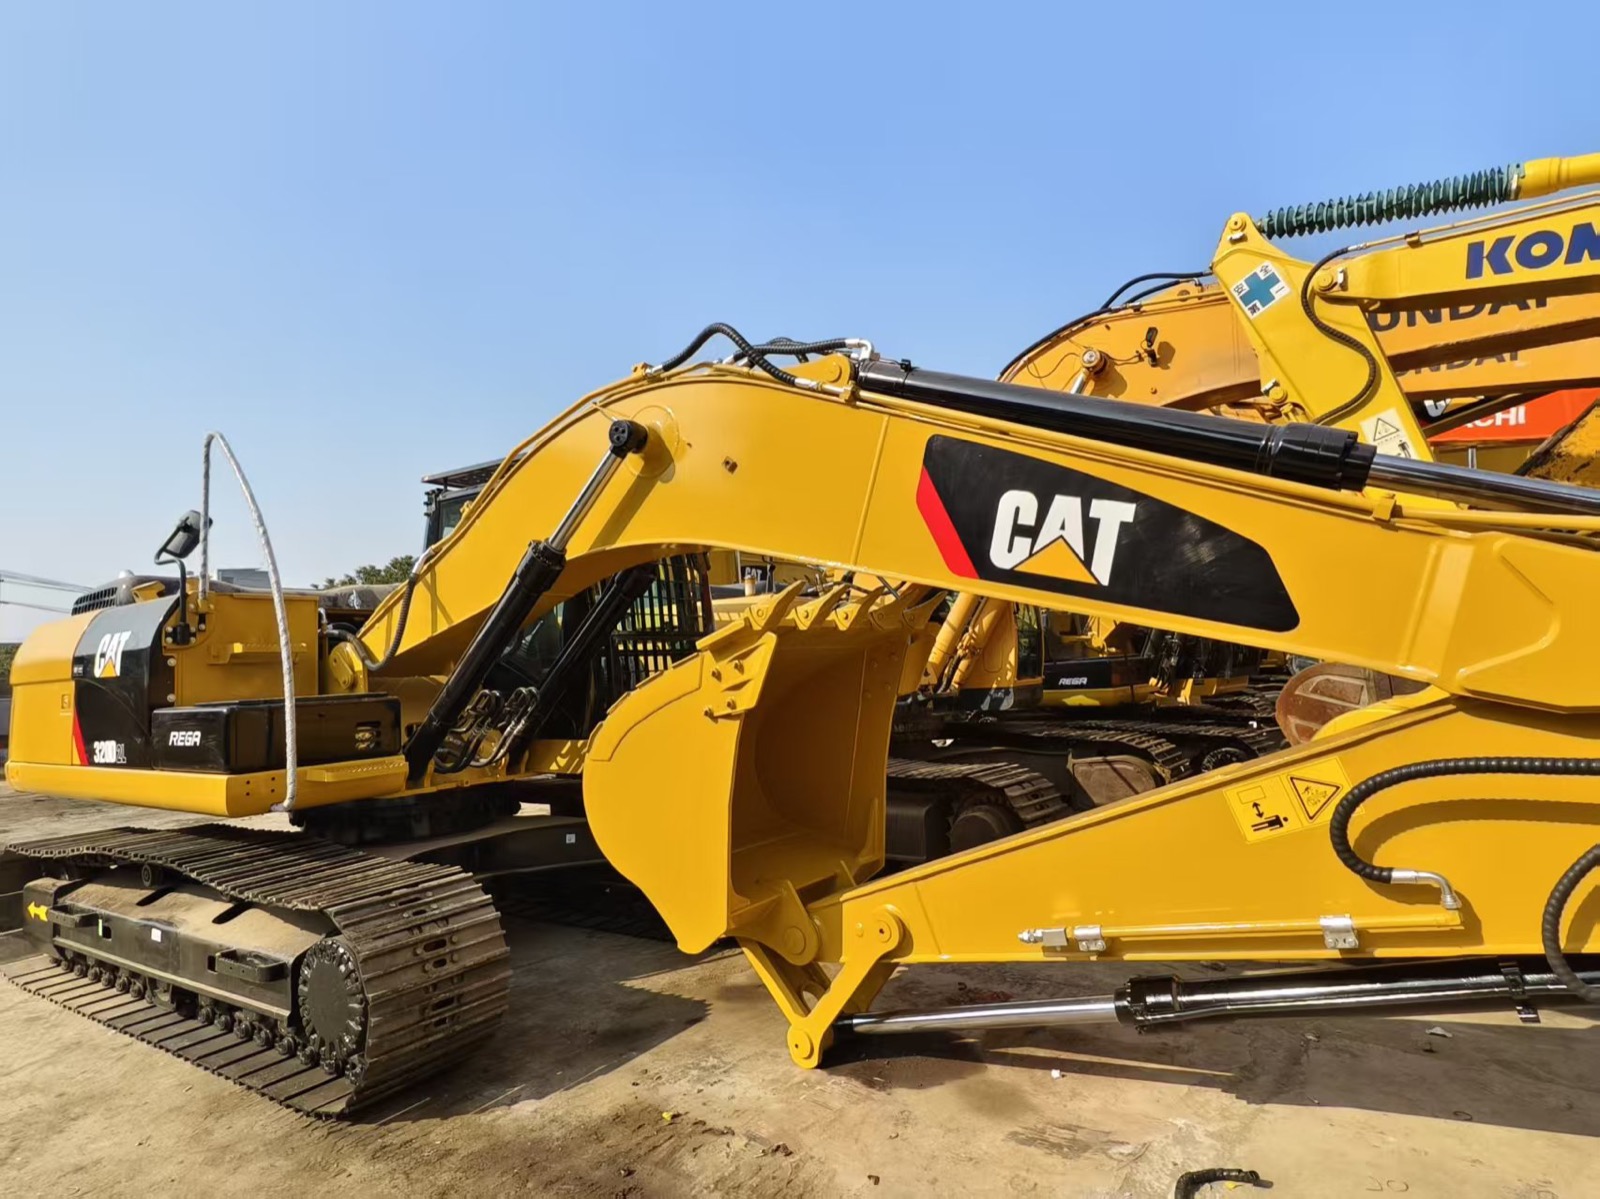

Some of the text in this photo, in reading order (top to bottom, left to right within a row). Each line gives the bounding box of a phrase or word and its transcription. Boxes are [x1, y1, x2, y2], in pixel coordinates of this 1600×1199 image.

[989, 489, 1137, 586] CAT
[93, 630, 132, 678] CAT
[1058, 677, 1088, 686] REGA
[168, 731, 202, 746] REGA
